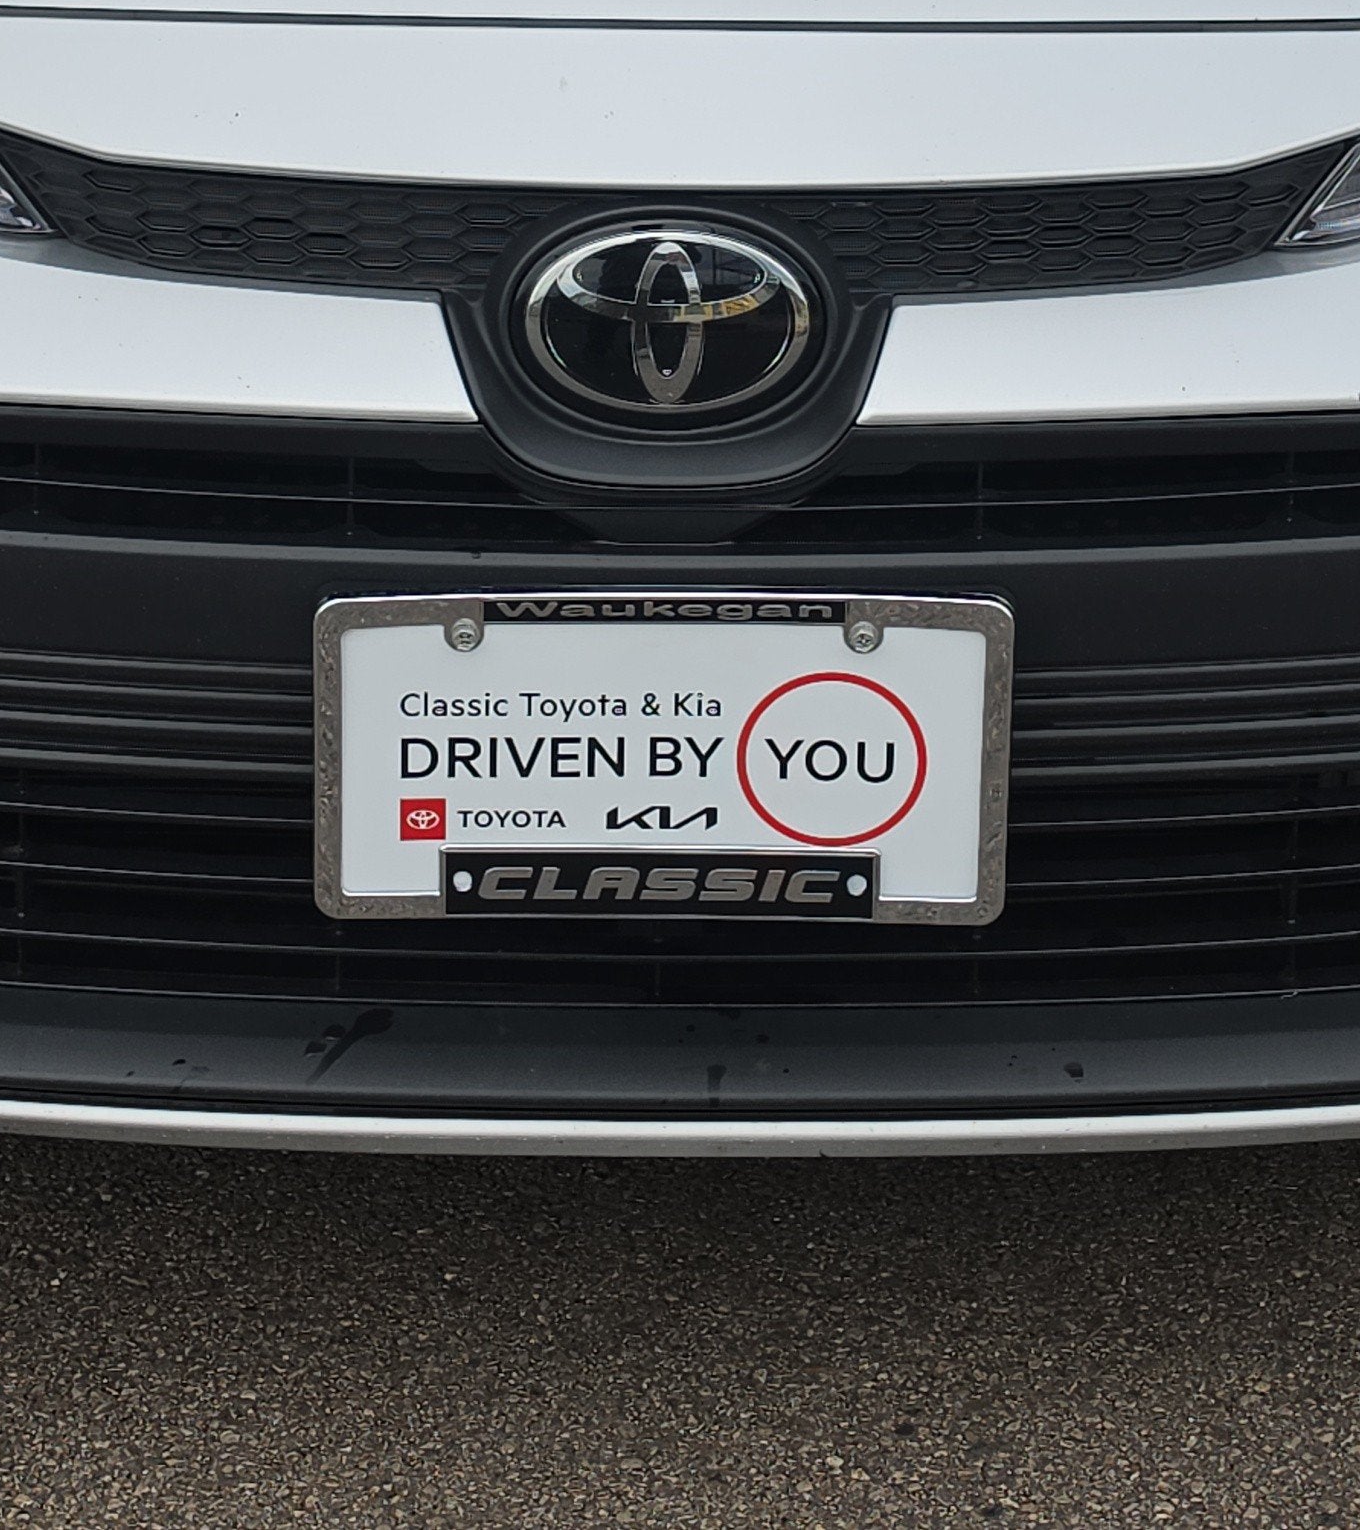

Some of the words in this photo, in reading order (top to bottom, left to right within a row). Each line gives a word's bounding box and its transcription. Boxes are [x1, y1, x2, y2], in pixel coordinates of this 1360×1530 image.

[496, 601, 833, 620] Waukegan
[399, 692, 509, 718] Classic
[519, 692, 628, 722] Toyota
[640, 692, 661, 717] &
[673, 692, 722, 717] Kia
[400, 737, 627, 779] DRIVEN
[649, 737, 724, 778] BY
[764, 738, 896, 783] YOU
[457, 809, 566, 829] TOYOTA
[478, 867, 840, 903] CLASSIC
